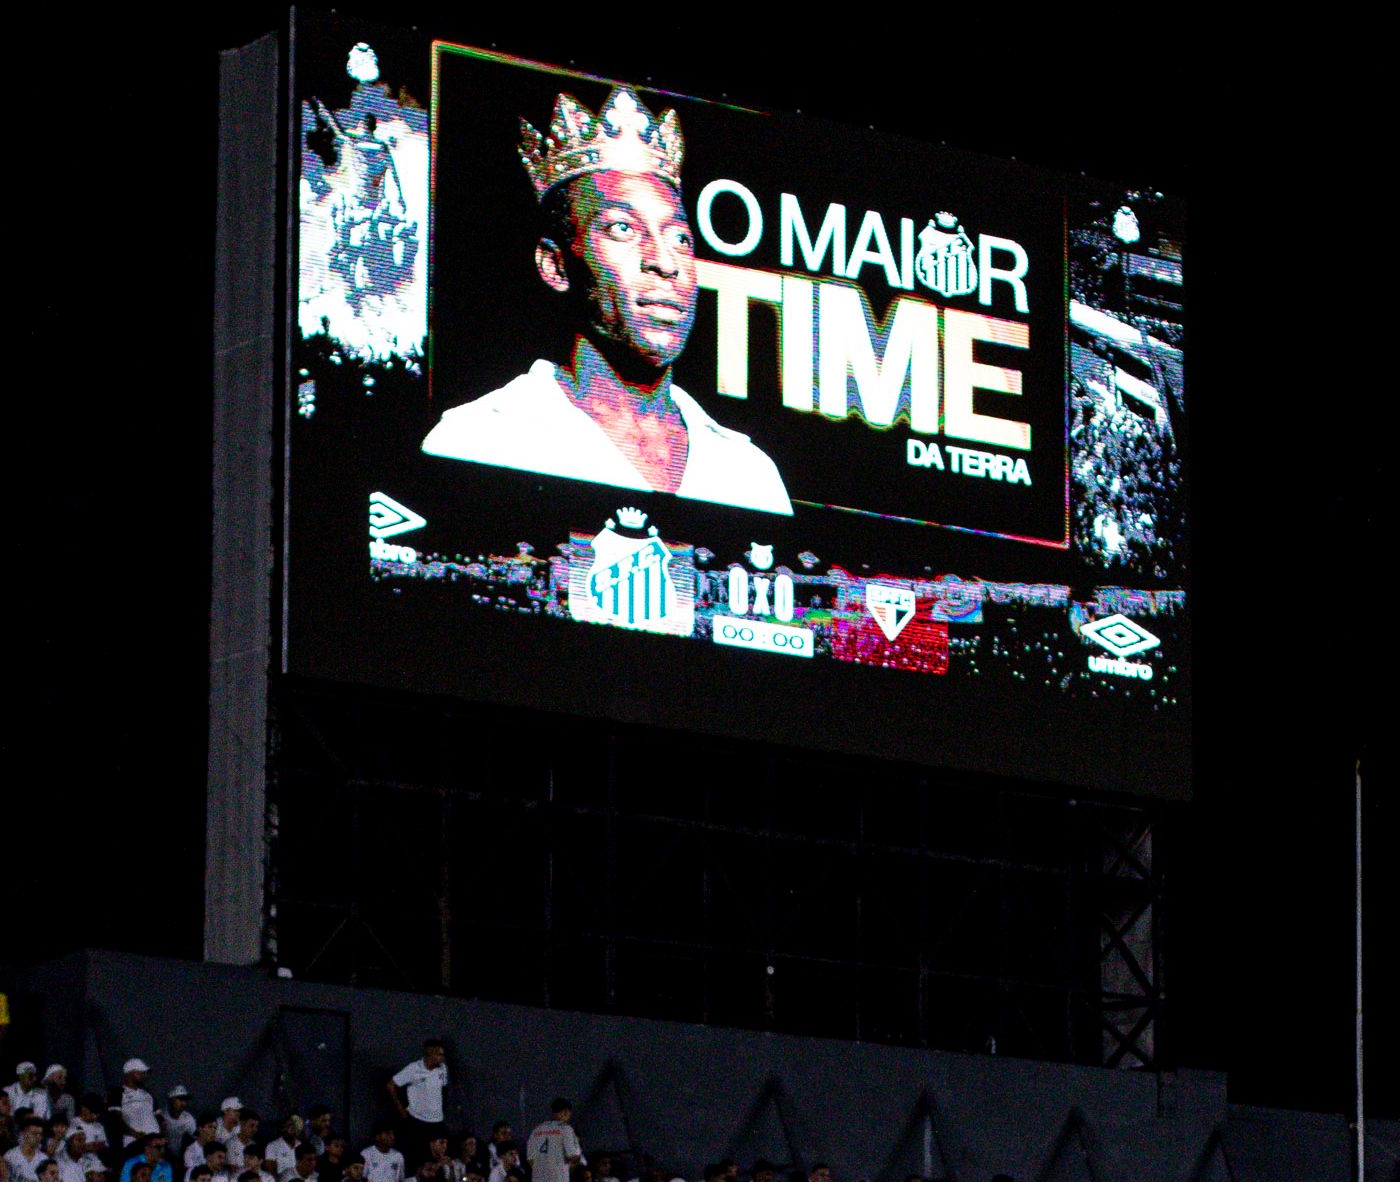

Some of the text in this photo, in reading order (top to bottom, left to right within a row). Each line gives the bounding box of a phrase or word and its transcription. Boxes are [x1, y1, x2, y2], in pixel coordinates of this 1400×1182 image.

[696, 178, 763, 256] O
[693, 257, 1032, 451] TIME
[906, 438, 1033, 486] DA TERRA
